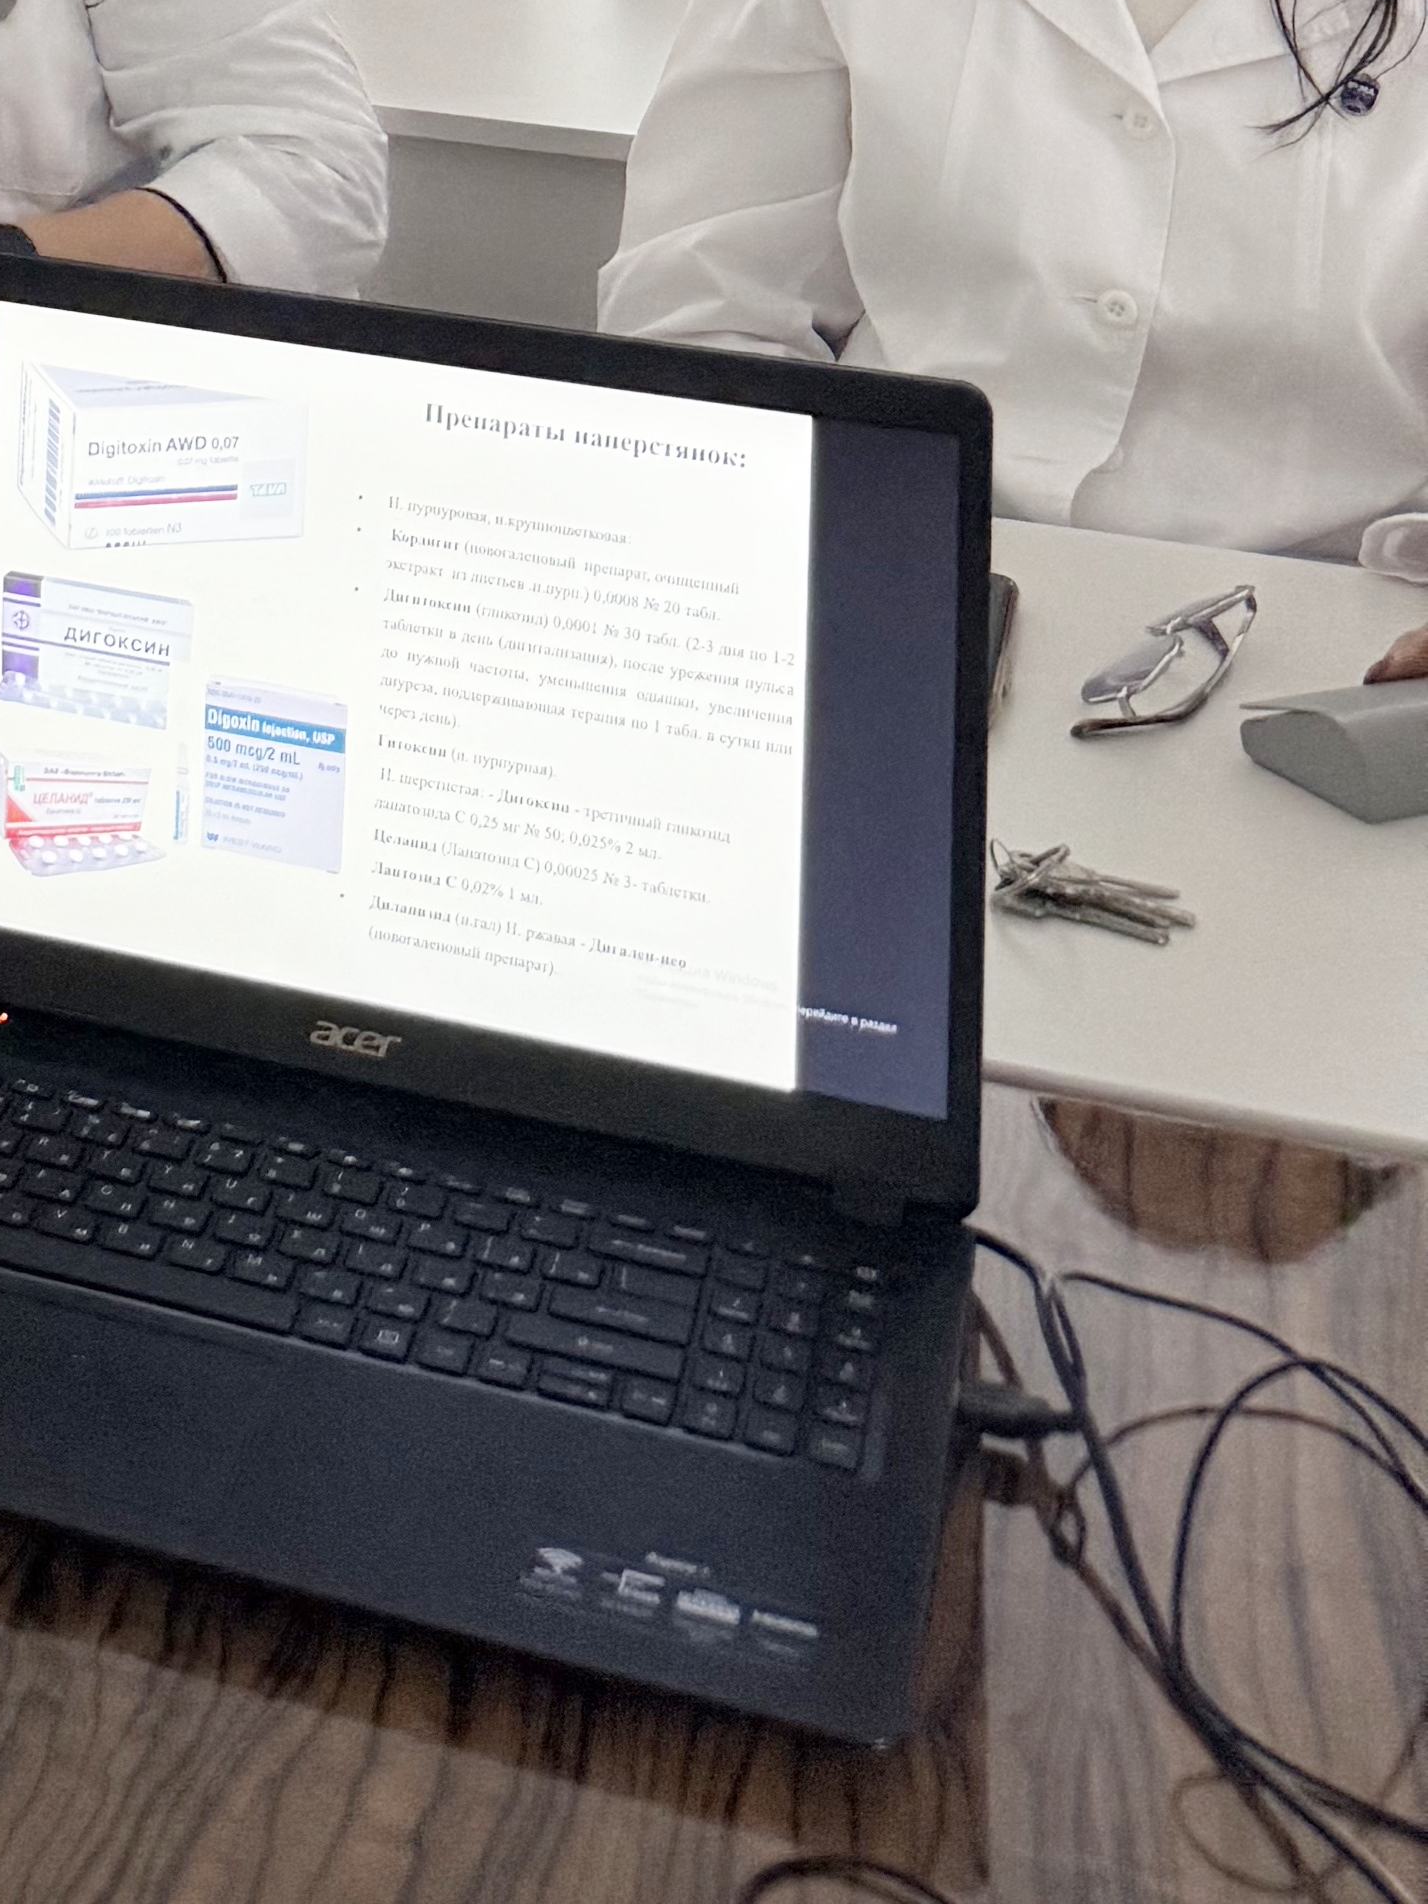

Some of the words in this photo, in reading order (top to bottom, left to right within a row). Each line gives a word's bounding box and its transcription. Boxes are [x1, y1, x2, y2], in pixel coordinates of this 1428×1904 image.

[88, 439, 162, 459] Digitoxin
[165, 436, 207, 452] AWD
[211, 436, 240, 450] 0,07
[426, 403, 564, 441] Препараты
[574, 430, 745, 467] наперстянок:
[584, 561, 650, 582] препарат,
[387, 559, 443, 577] экстракт
[593, 589, 638, 607] 0,0008
[663, 600, 680, 614] 20
[686, 606, 722, 621] табл.
[63, 626, 171, 657] ДИГОКСИН
[383, 618, 443, 637] таблетки
[461, 632, 493, 645] день
[622, 658, 664, 674] после
[624, 626, 640, 641] 30
[685, 636, 713, 652] (2-3
[749, 649, 767, 661] по
[380, 647, 398, 658] до
[407, 651, 459, 669] нужной
[469, 662, 528, 681] частоты,
[207, 708, 260, 732] Digoxin
[312, 730, 336, 746] USP
[379, 704, 415, 720] через
[571, 708, 625, 726] терапия
[631, 719, 648, 730] по
[719, 734, 760, 749] сутки
[765, 741, 792, 755] или
[207, 735, 232, 753] 500
[234, 742, 276, 762] mcg/2
[280, 750, 301, 766] mL
[469, 813, 498, 829] 0,25
[502, 822, 520, 833] мг
[569, 831, 620, 853] 0,025%
[373, 828, 436, 852] Целанид
[543, 860, 597, 882] 0,00025
[460, 878, 503, 897] 0,02%
[309, 1020, 402, 1058] acer
